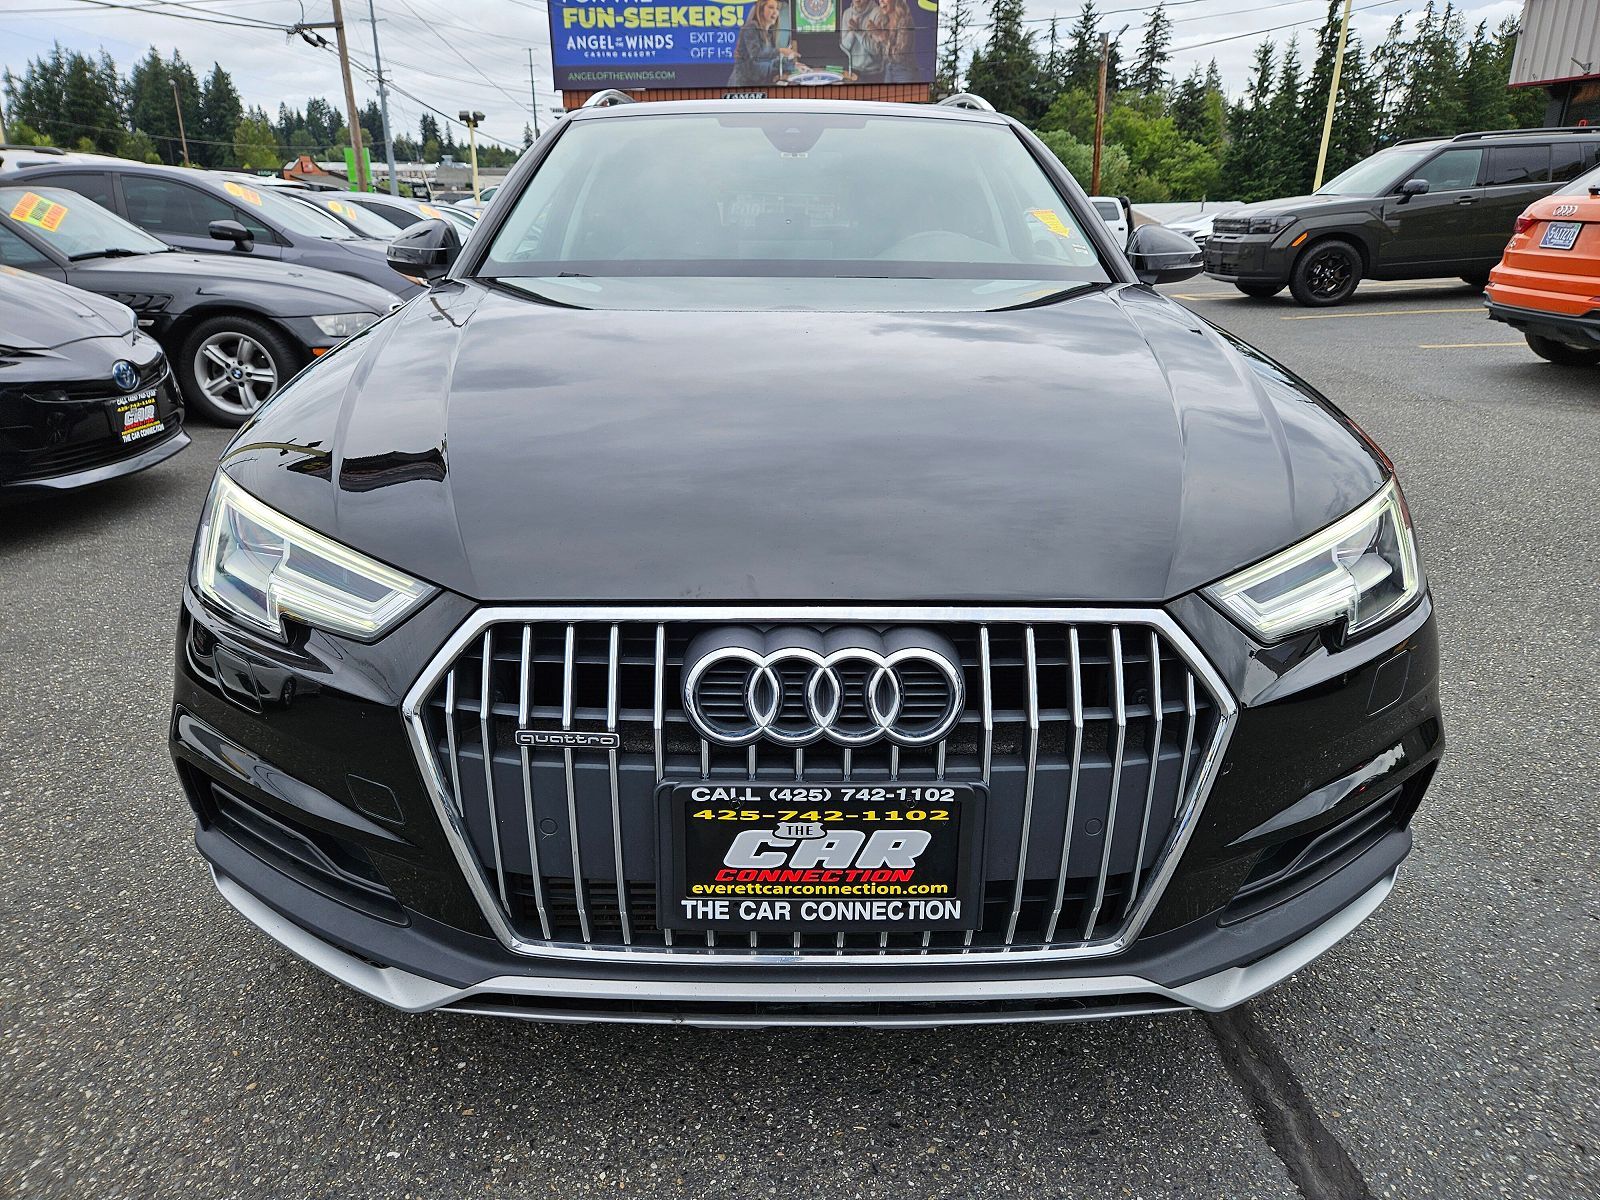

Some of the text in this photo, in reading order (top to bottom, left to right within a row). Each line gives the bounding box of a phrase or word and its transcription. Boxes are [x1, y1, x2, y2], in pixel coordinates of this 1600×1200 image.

[563, 5, 744, 29] FUN-SEEKERS!
[566, 35, 615, 50] ANGEL
[625, 34, 674, 50] WINDS
[689, 31, 736, 44] EXIT 210
[690, 47, 733, 59] OFF I-5
[568, 70, 676, 81] ANGELOFTHEWINDS.COM
[520, 734, 615, 744] quattro
[691, 787, 955, 802] CALL (425) 742-1102
[692, 809, 950, 821] 425-742-1102
[786, 825, 813, 836] THE
[723, 829, 932, 869] CAR
[714, 869, 914, 882] CONNECTION
[691, 882, 948, 896] everettcarconnection.com
[681, 900, 961, 921] THE CAR CONNECTION
